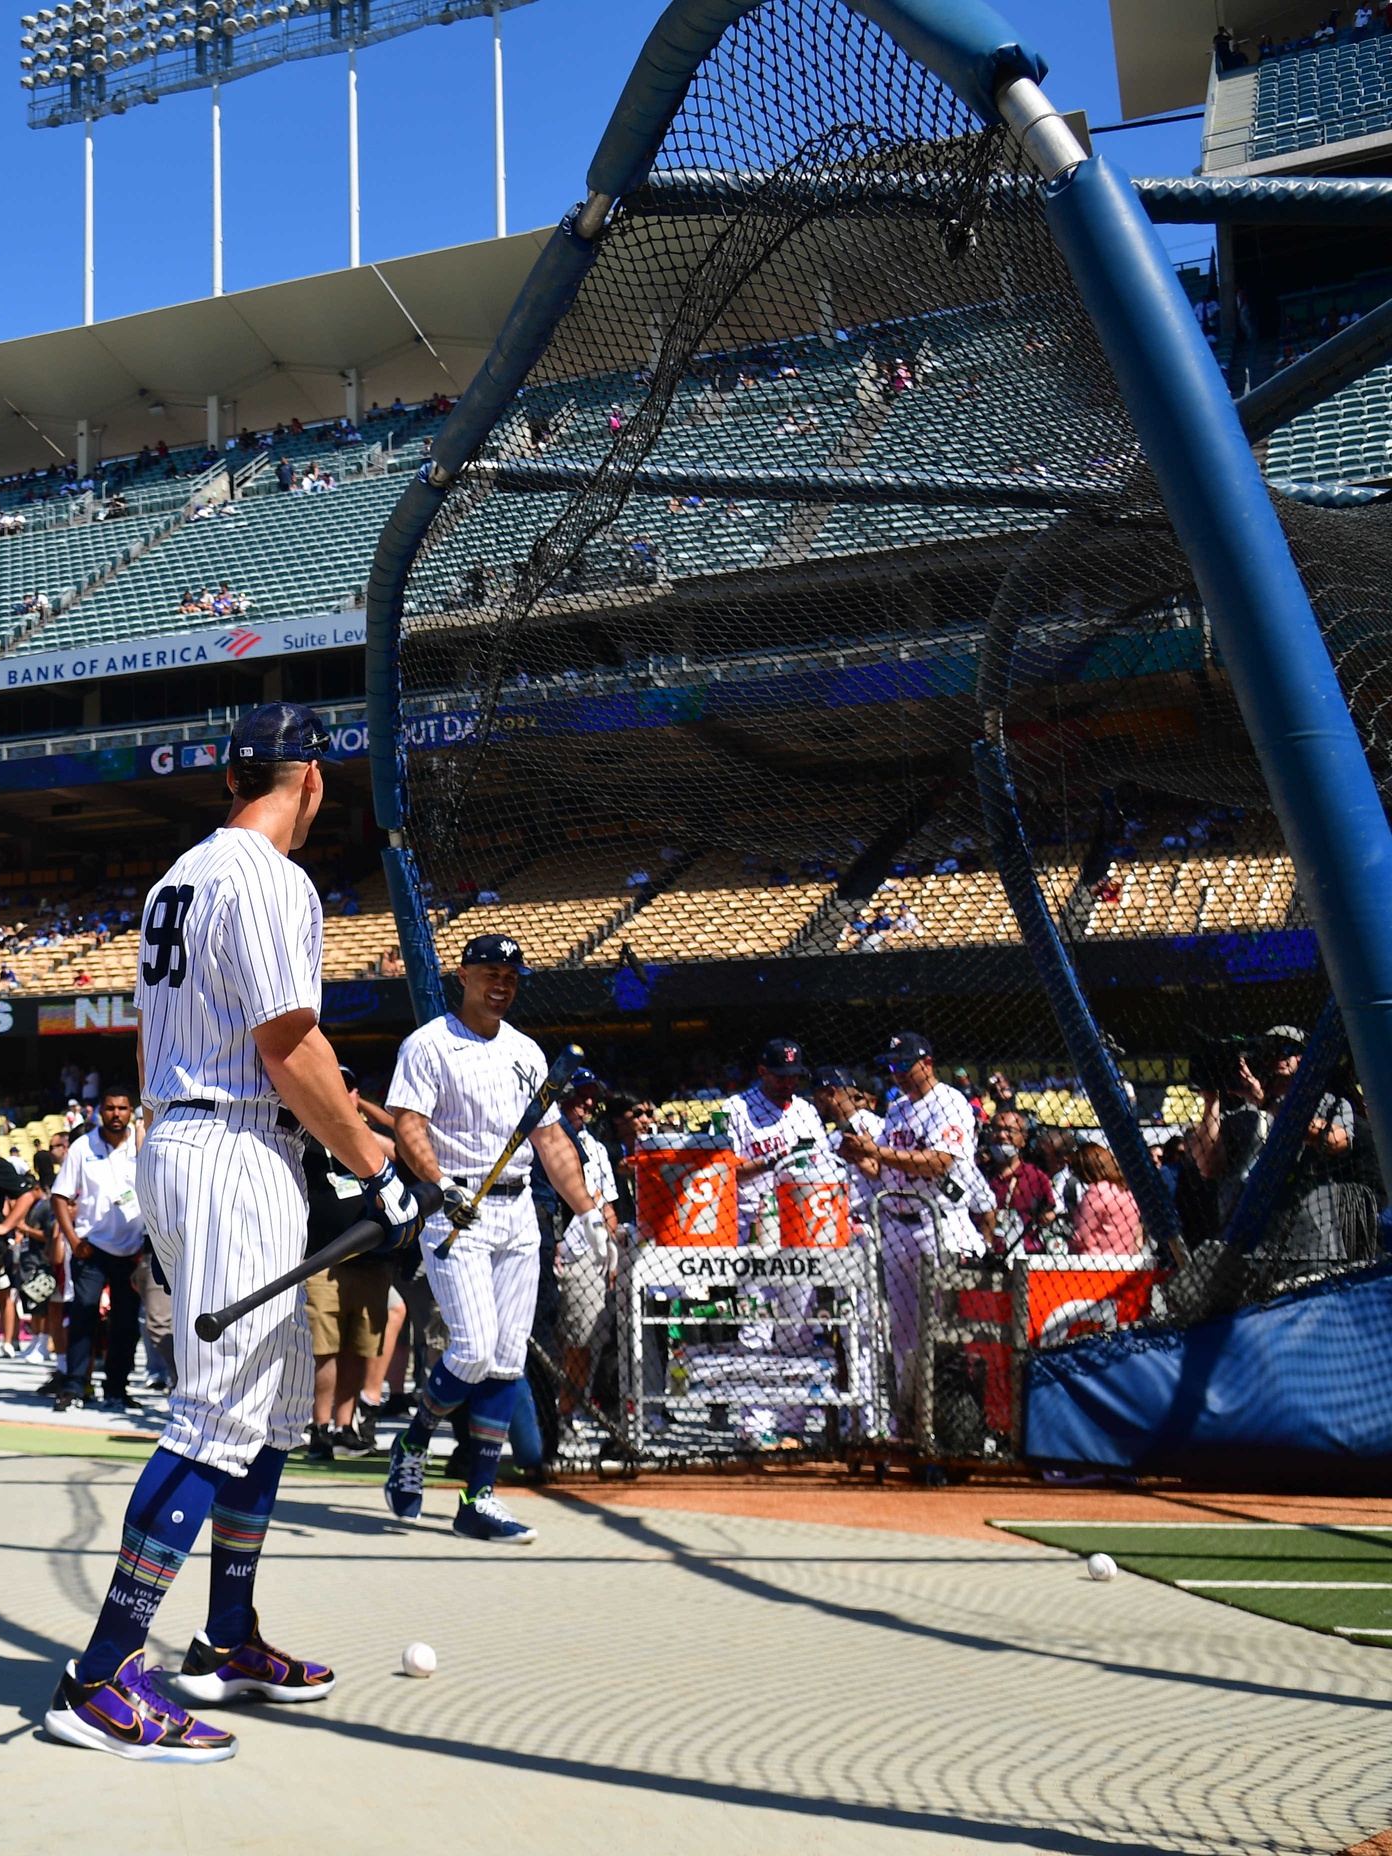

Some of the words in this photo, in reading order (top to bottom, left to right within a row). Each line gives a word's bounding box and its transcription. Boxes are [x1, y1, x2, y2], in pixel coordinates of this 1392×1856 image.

[8, 663, 65, 685] BANK
[72, 658, 99, 678] OF
[105, 645, 208, 673] AMERICA
[283, 632, 328, 650] Suite
[333, 628, 368, 644] Lev
[73, 996, 138, 1029] NL
[677, 1257, 822, 1277] GATORADE
[108, 1585, 127, 1606] ALL
[133, 1587, 153, 1599] LOS
